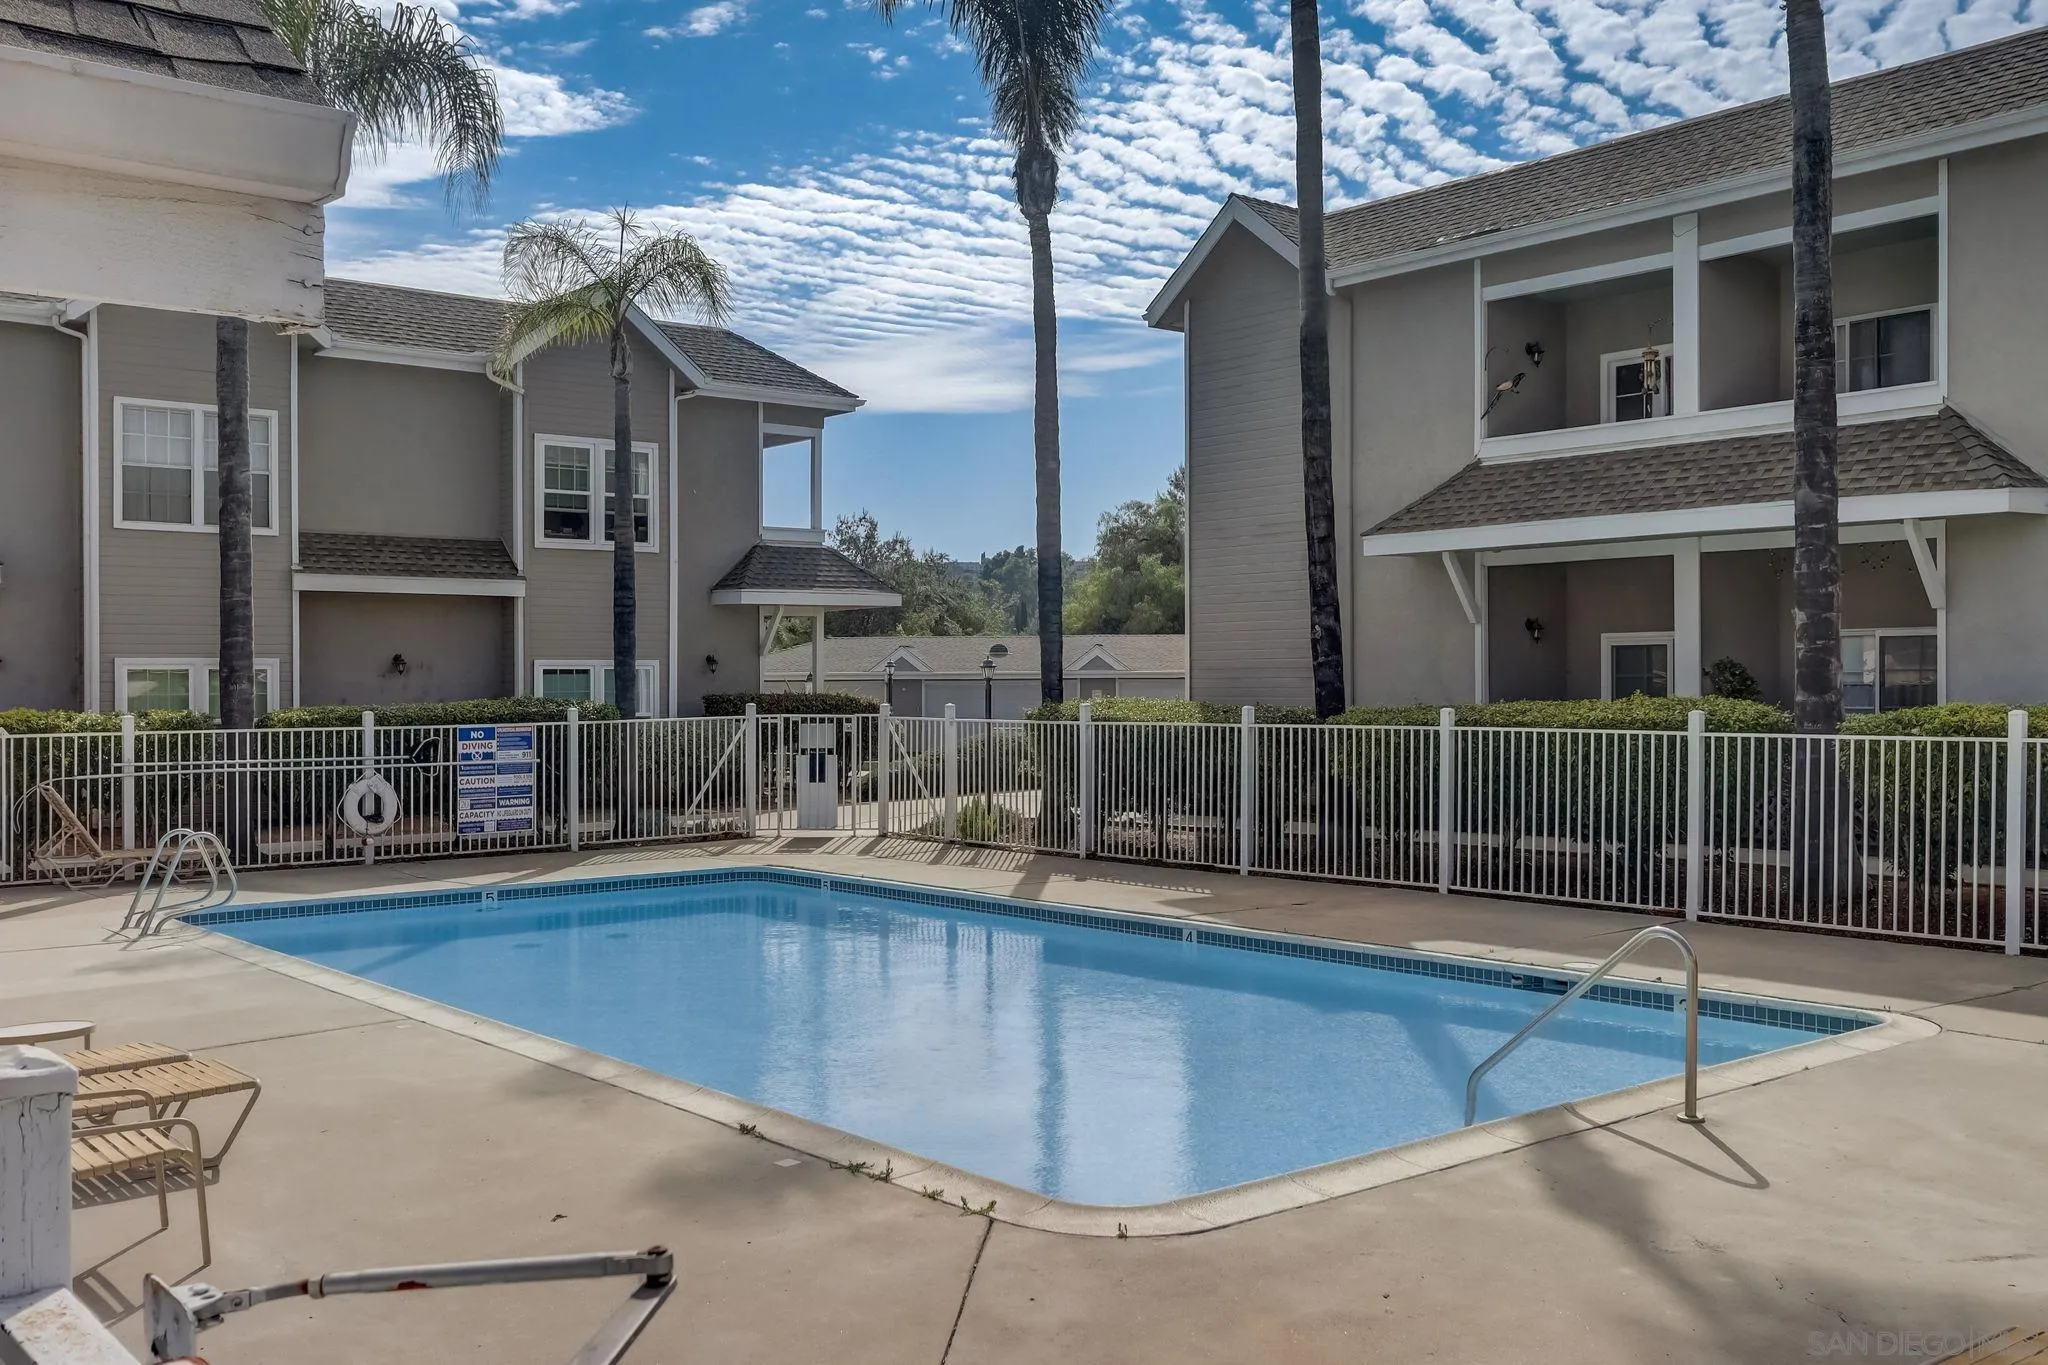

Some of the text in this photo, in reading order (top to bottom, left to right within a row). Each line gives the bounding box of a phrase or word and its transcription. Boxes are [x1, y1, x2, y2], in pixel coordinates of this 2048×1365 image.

[470, 731, 484, 739] NO
[462, 742, 493, 750] DIVING
[459, 777, 495, 786] CAUTION
[498, 797, 530, 806] WARNING
[459, 810, 495, 819] CAPACITY
[485, 892, 495, 902] 5
[1186, 931, 1194, 942] 4
